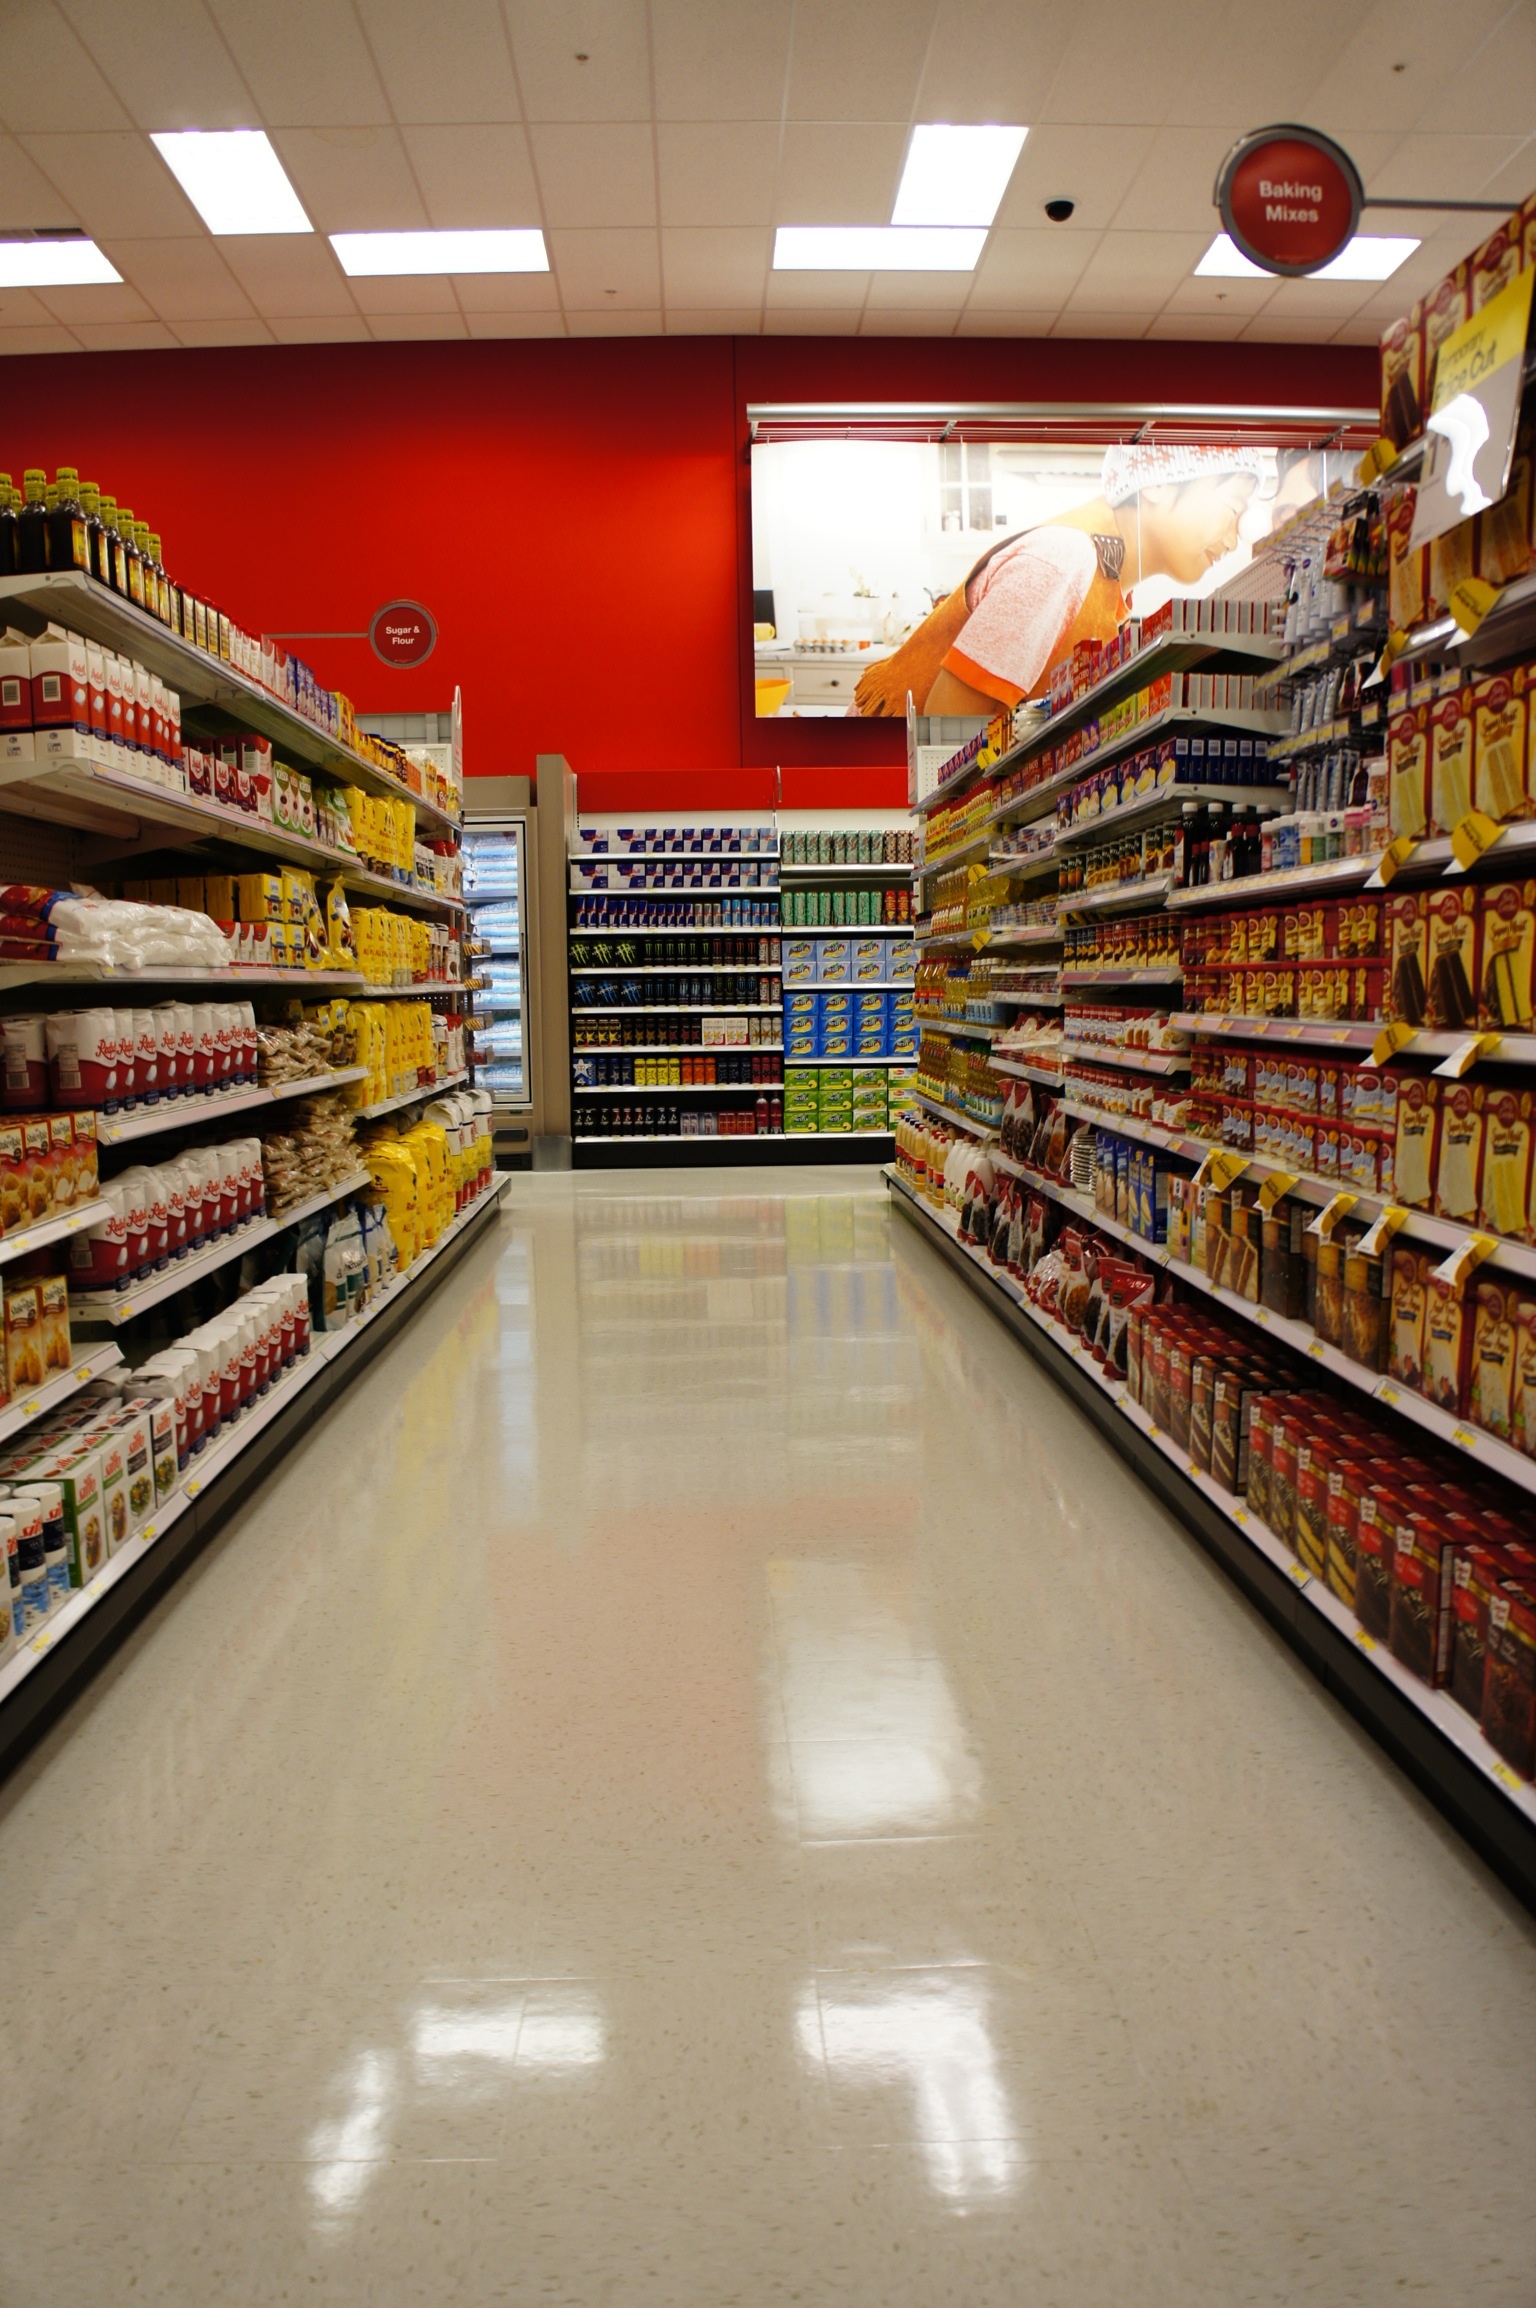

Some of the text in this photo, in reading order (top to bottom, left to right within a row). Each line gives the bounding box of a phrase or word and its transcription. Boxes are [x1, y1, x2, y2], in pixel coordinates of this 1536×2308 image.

[1259, 180, 1322, 202] Baking
[1265, 205, 1319, 223] Mixes
[385, 625, 420, 636] Sugar &
[392, 636, 415, 645] Flour
